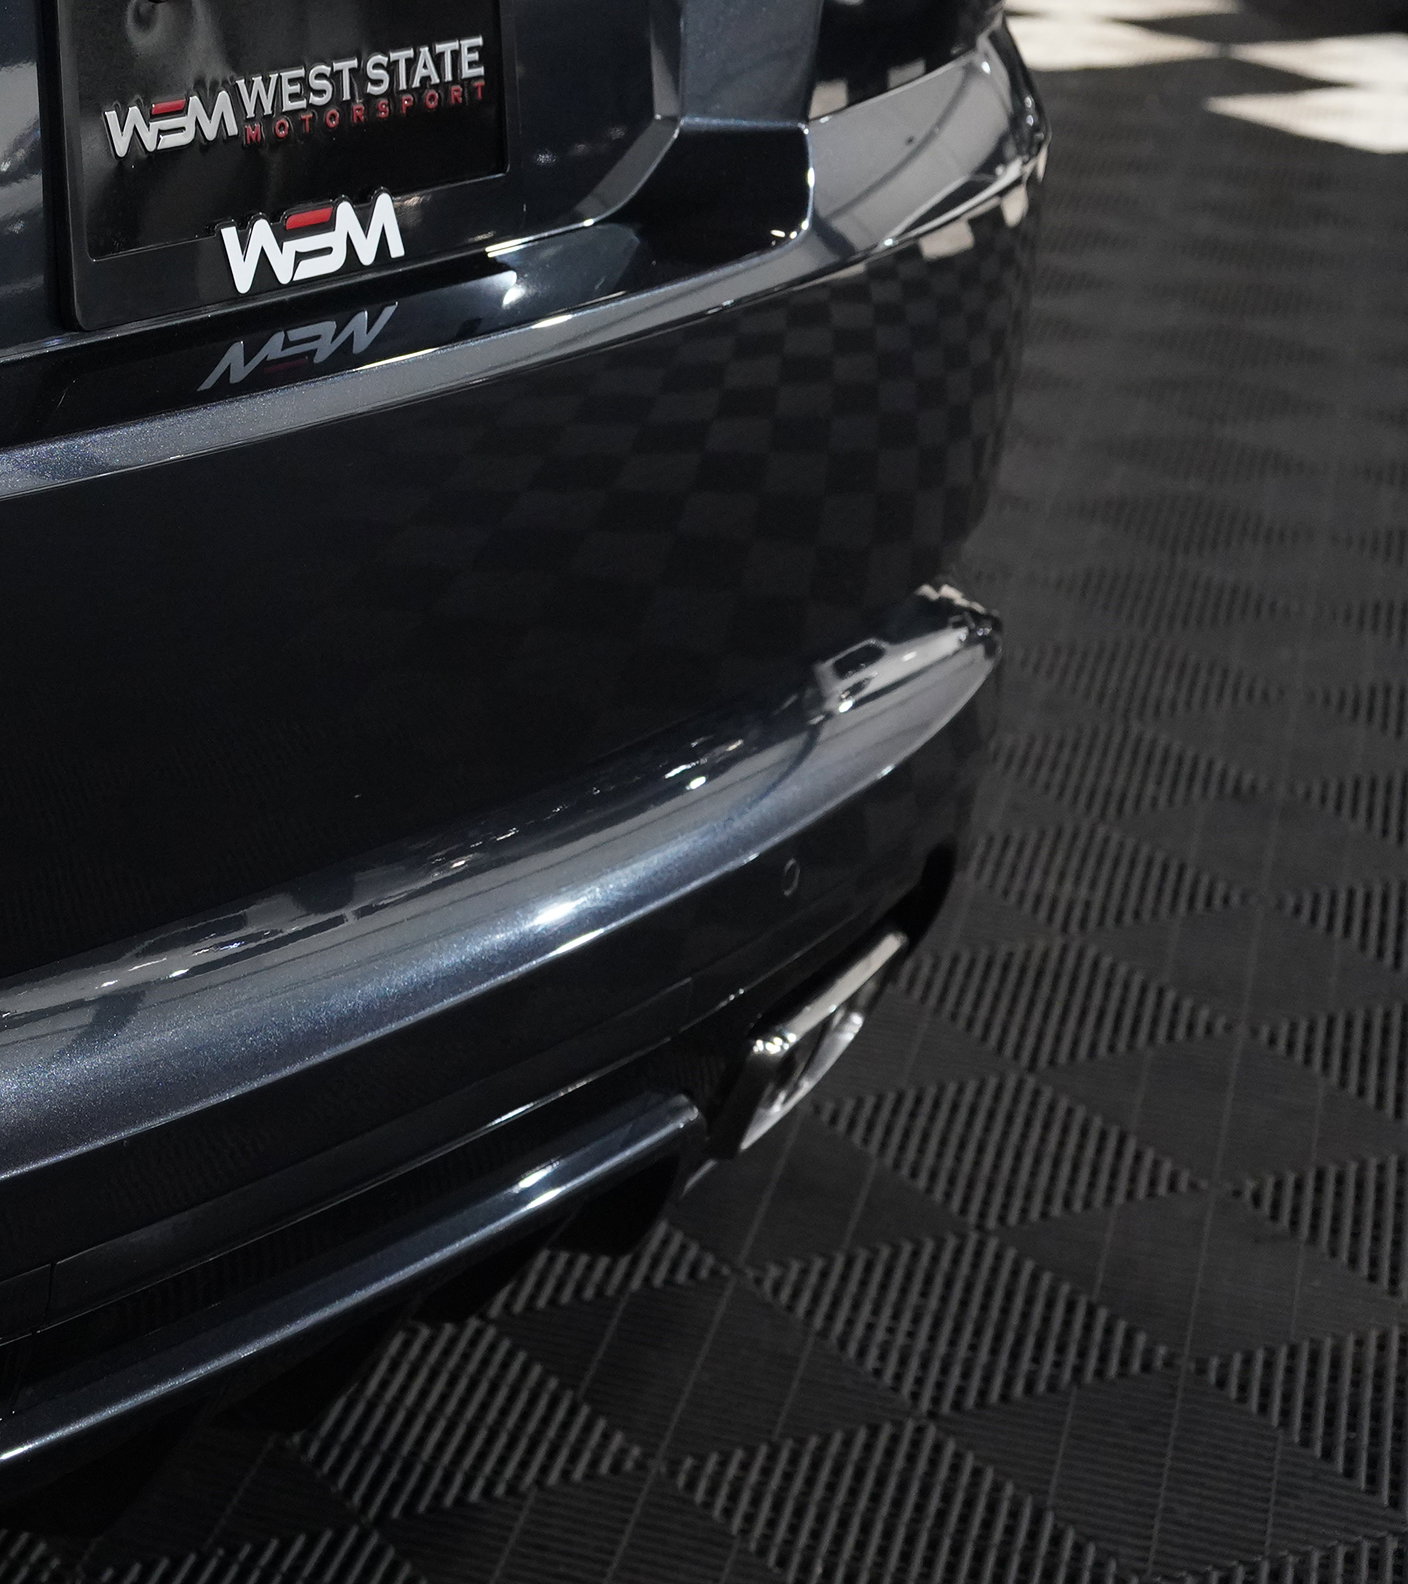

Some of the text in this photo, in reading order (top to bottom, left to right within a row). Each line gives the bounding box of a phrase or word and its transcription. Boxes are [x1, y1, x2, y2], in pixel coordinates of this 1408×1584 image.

[235, 36, 485, 117] WEST STATE
[244, 81, 485, 145] MOTORSPORT
[104, 89, 239, 158] WSM
[220, 192, 406, 295] WSM
